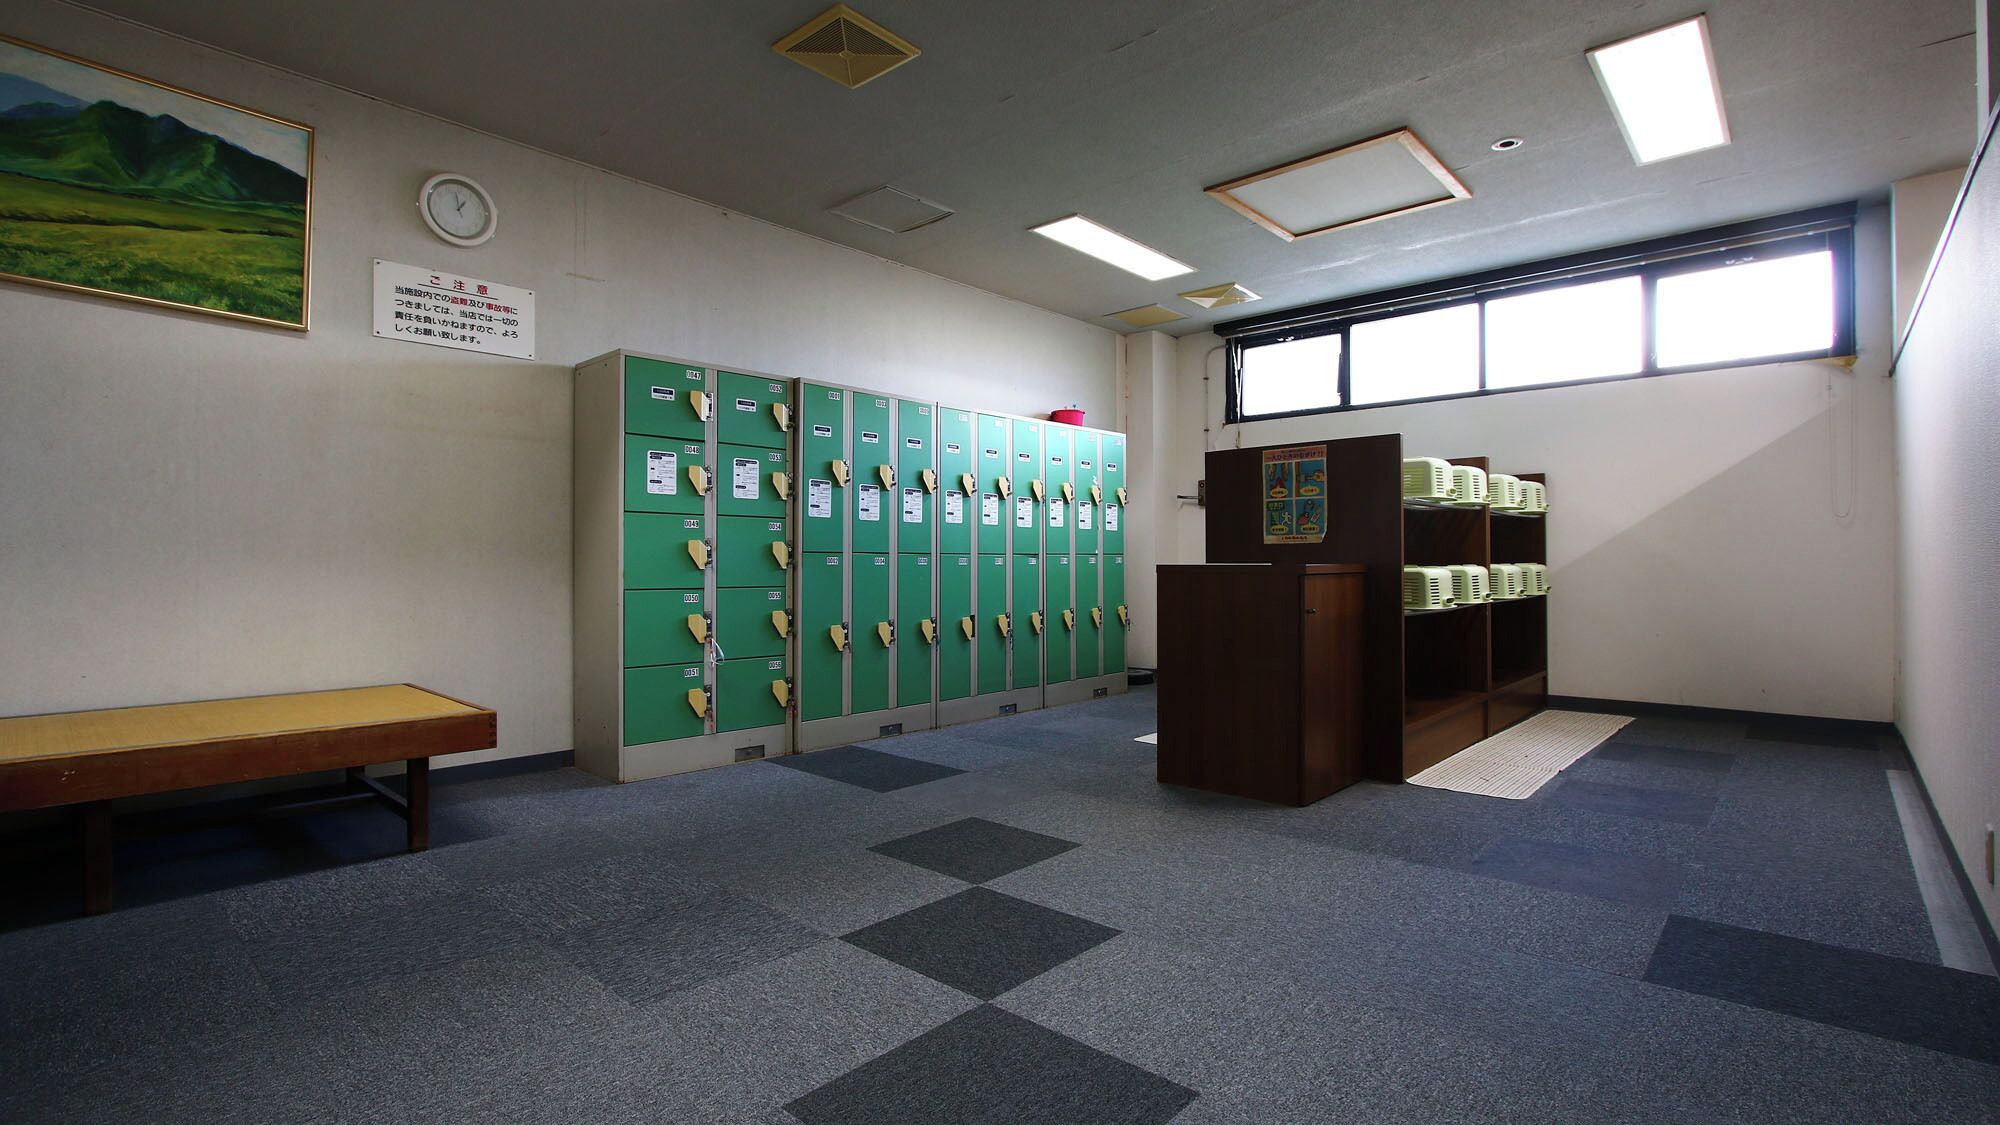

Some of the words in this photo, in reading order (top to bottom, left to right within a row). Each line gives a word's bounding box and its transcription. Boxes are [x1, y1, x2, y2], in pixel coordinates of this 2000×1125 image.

[430, 275, 488, 295] ご注意
[395, 285, 518, 315] 当施設内での盗難及び事故等に
[395, 299, 519, 326] つきましては、当店では一切の
[395, 311, 519, 338] 責任を負いかねますので、よろ
[395, 323, 481, 344] しくお願い致します。
[687, 370, 701, 380] 0047
